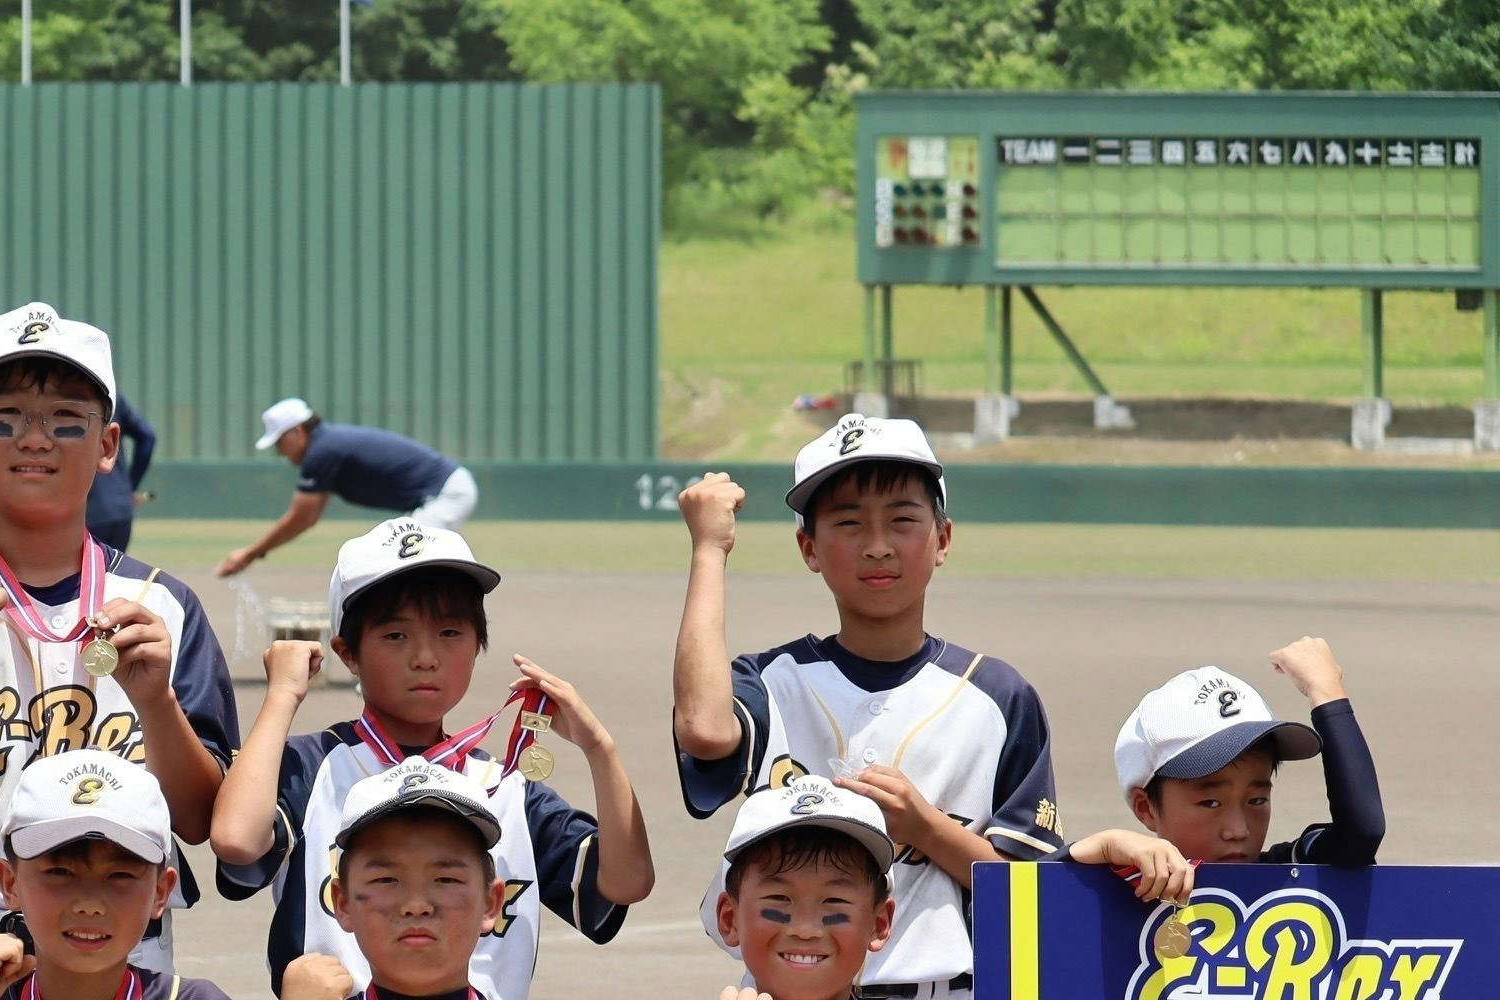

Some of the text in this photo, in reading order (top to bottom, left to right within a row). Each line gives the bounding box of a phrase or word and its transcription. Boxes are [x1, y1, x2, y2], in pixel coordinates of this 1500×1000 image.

[1000, 139, 1058, 164] TEAM
[1096, 139, 1120, 164] 二
[1127, 139, 1153, 165] 三
[1227, 141, 1249, 164] 六
[1292, 141, 1314, 165] 八
[1355, 140, 1380, 165] 十
[633, 473, 703, 511] 12
[59, 763, 123, 791] TOKAMACHI
[383, 764, 450, 784] TOKAMACHI
